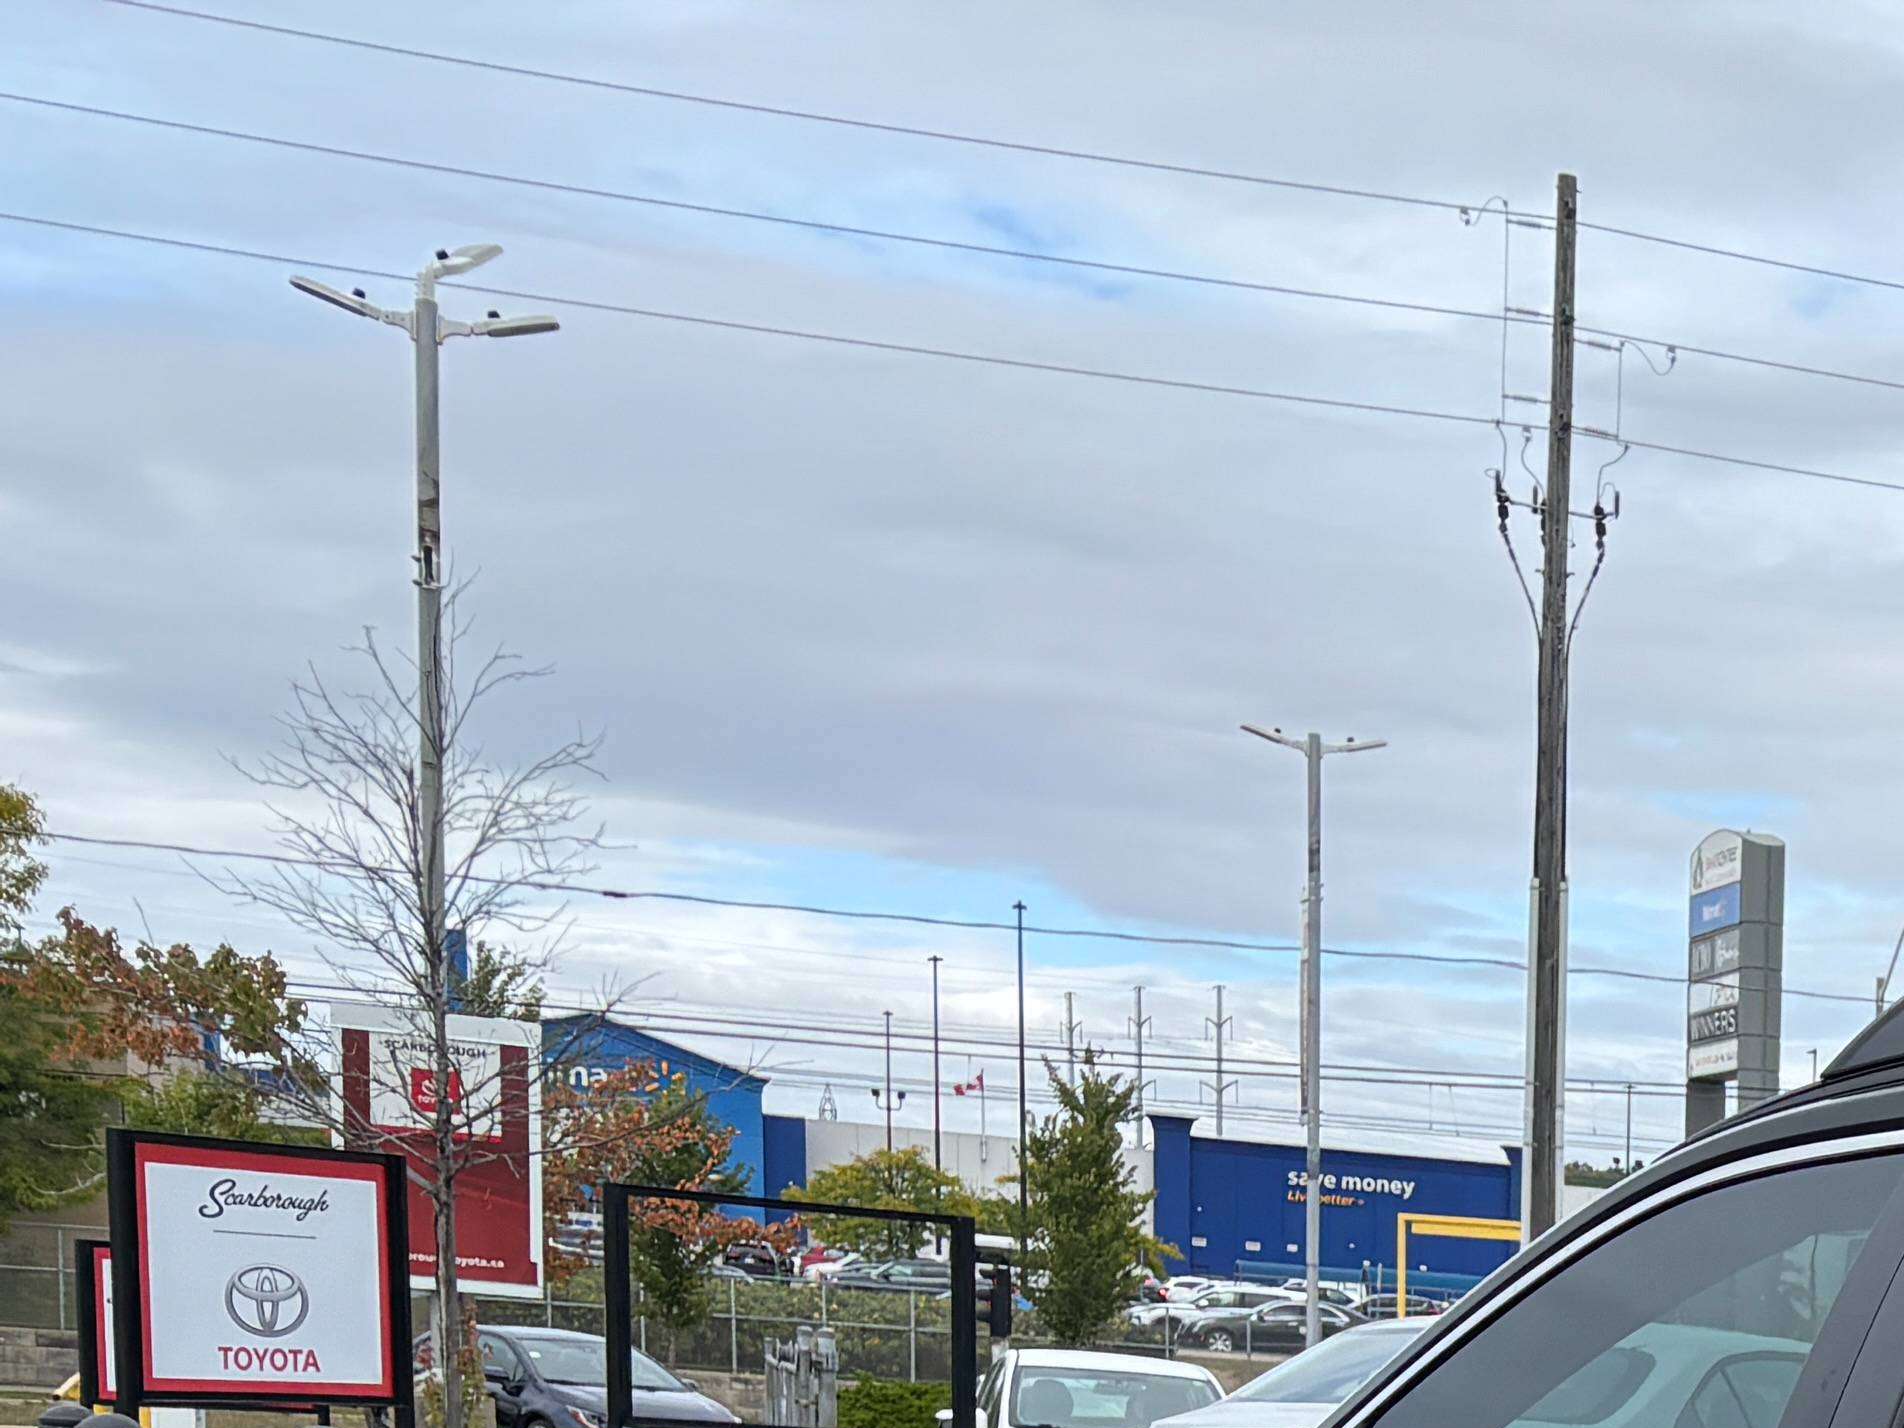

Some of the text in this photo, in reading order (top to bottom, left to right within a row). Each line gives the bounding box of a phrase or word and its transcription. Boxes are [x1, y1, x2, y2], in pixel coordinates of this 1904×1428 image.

[383, 1040, 486, 1058] SCARBOOUGH
[198, 1178, 330, 1222] Scarborough
[1341, 1175, 1416, 1200] money
[217, 1346, 321, 1373] TOYOTA
